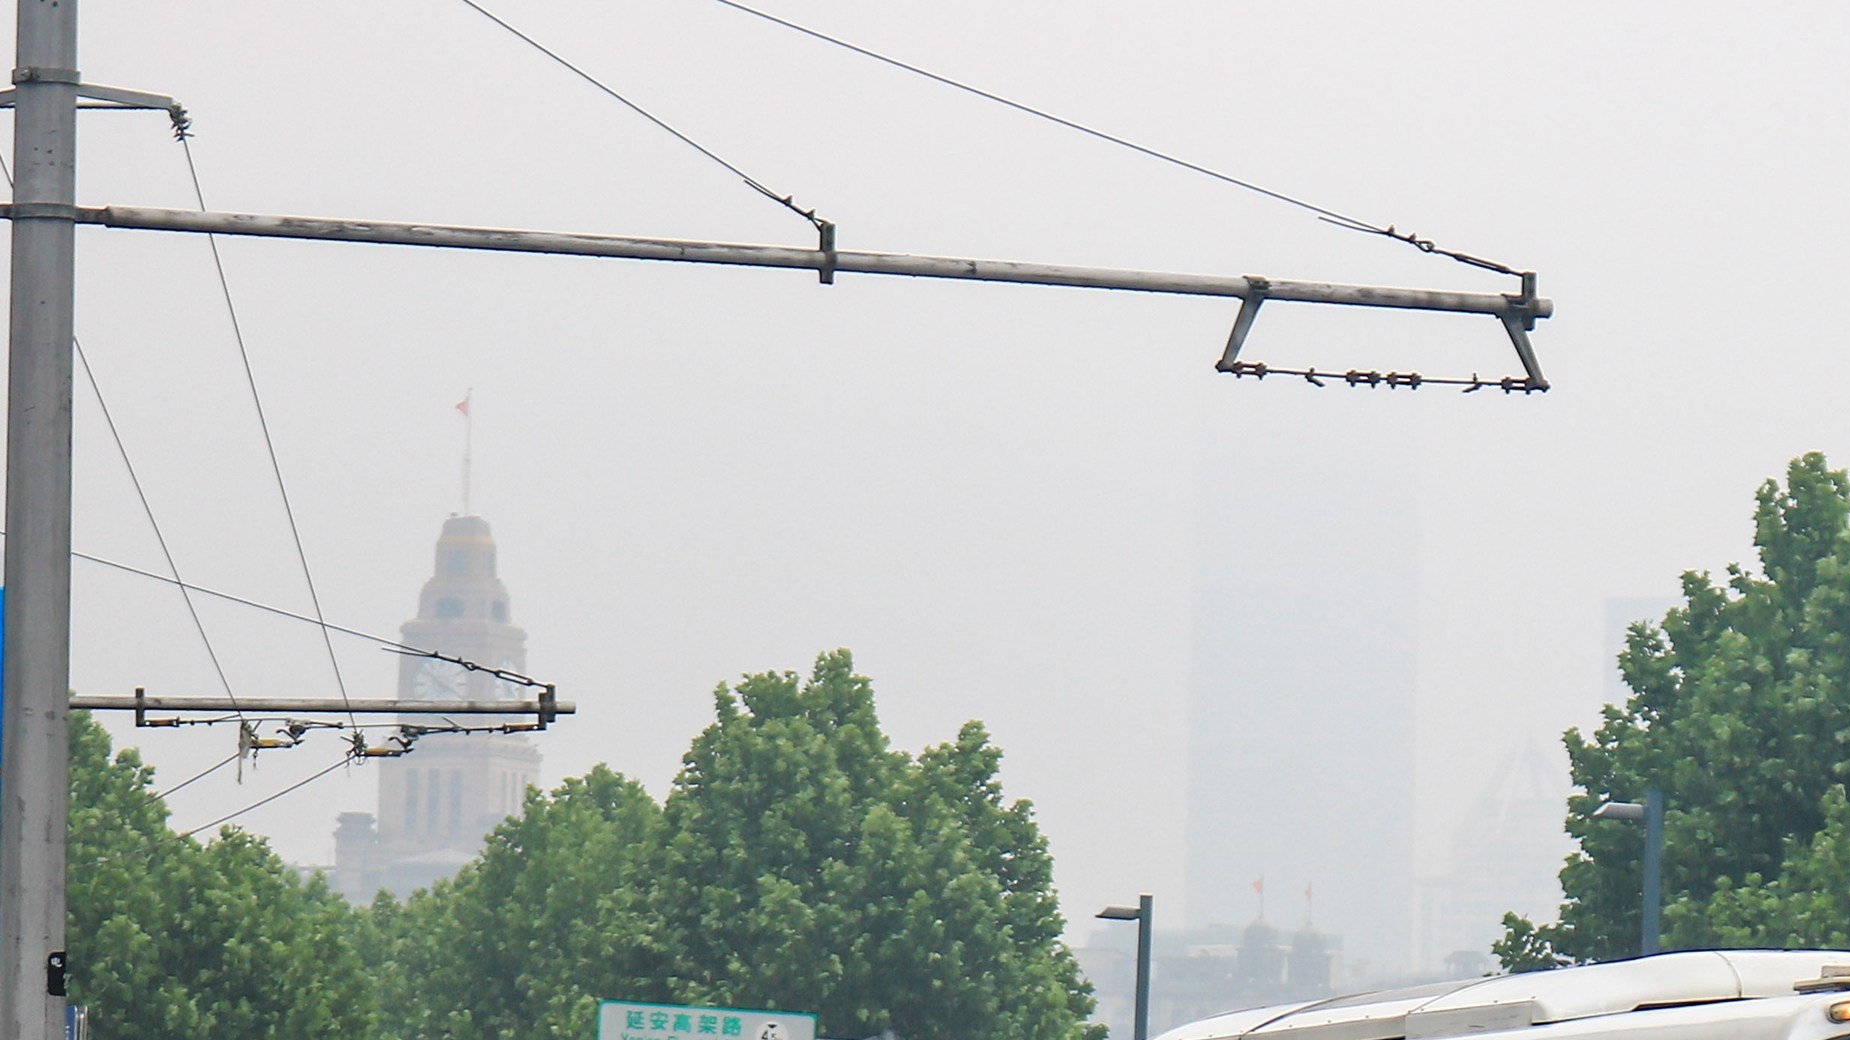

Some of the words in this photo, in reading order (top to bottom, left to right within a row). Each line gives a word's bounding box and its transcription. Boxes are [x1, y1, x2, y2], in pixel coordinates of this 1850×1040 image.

[626, 1010, 742, 1037] 延安高架路
